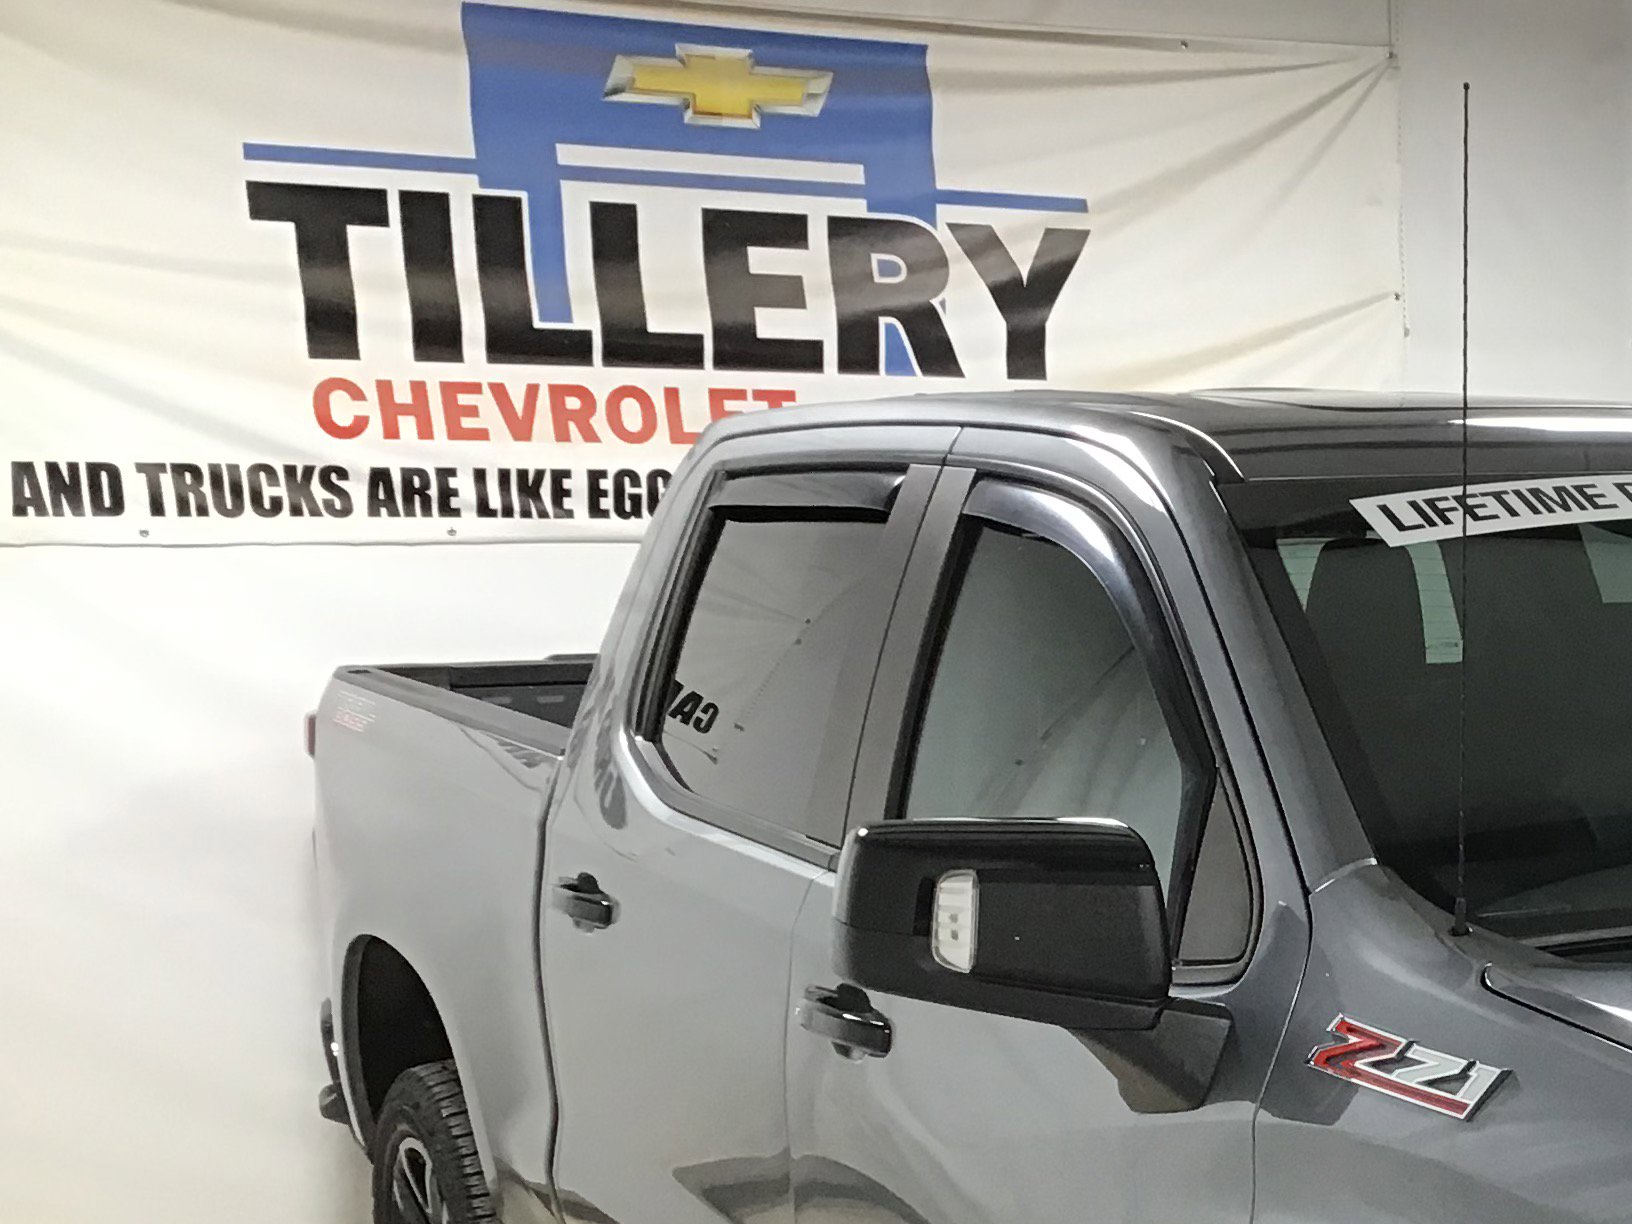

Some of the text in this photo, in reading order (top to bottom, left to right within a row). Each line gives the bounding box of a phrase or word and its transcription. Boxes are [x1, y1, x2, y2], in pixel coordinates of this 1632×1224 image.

[245, 180, 1091, 380] TILLERY
[10, 461, 126, 518] AND
[134, 461, 354, 519] TRUCKS
[366, 466, 459, 519] ARE
[473, 467, 575, 519] LIKE
[1376, 483, 1618, 532] LIFETIME
[1304, 1012, 1514, 1122] Z71
